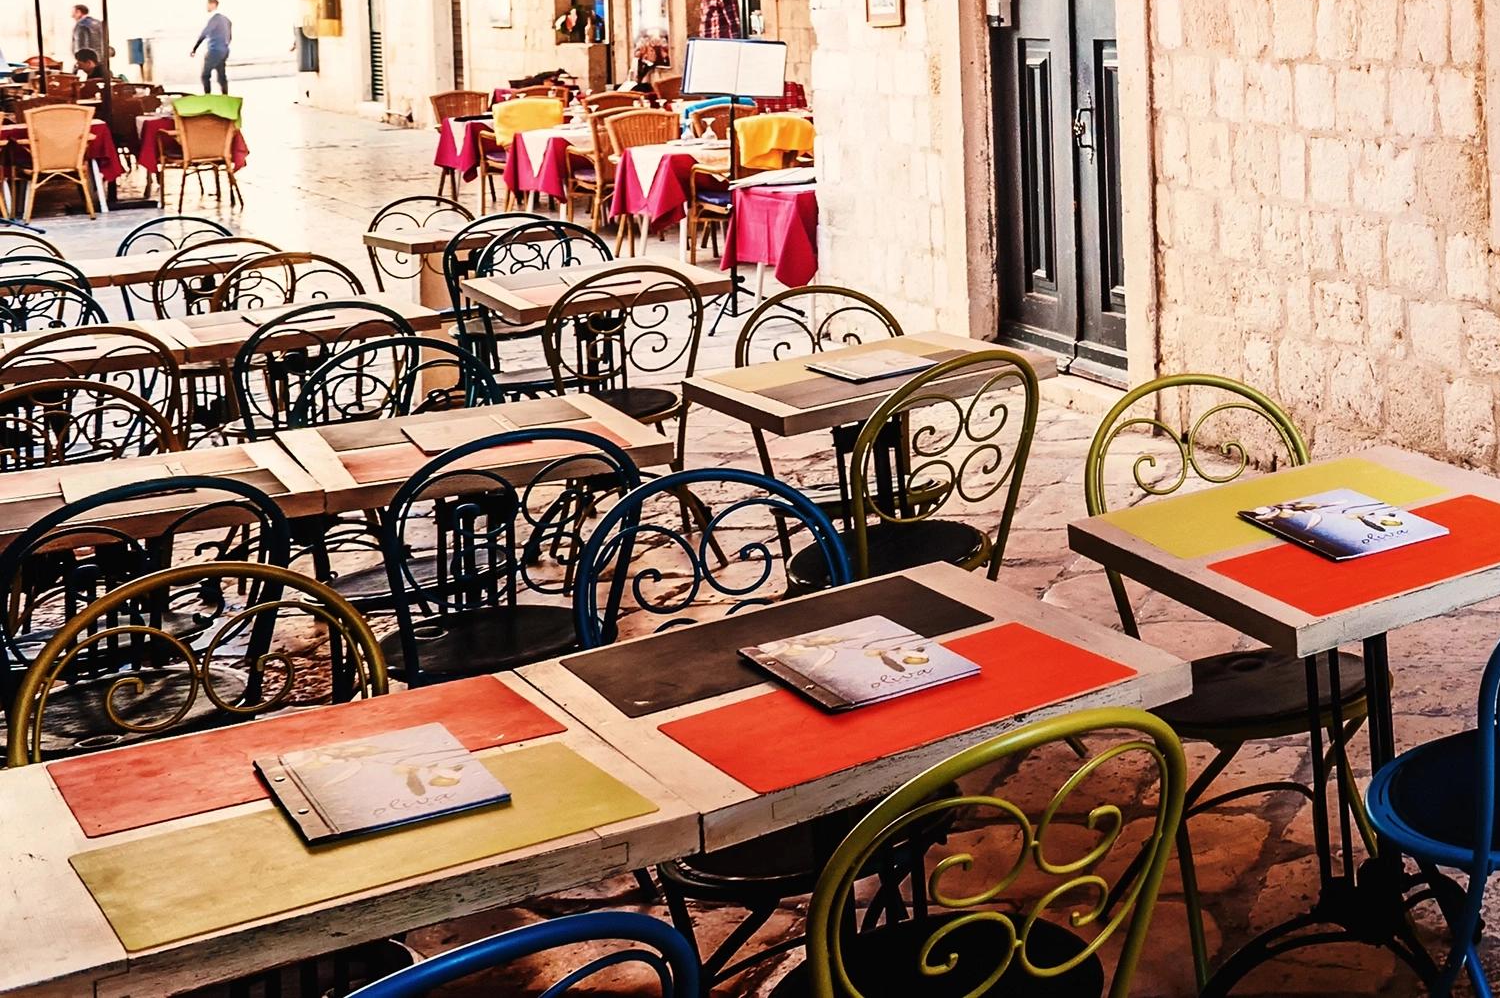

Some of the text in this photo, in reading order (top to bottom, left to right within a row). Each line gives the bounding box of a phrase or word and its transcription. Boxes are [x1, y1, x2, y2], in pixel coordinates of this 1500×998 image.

[1361, 527, 1409, 545] oliva
[871, 667, 934, 690] oliva
[372, 792, 458, 817] oliva
